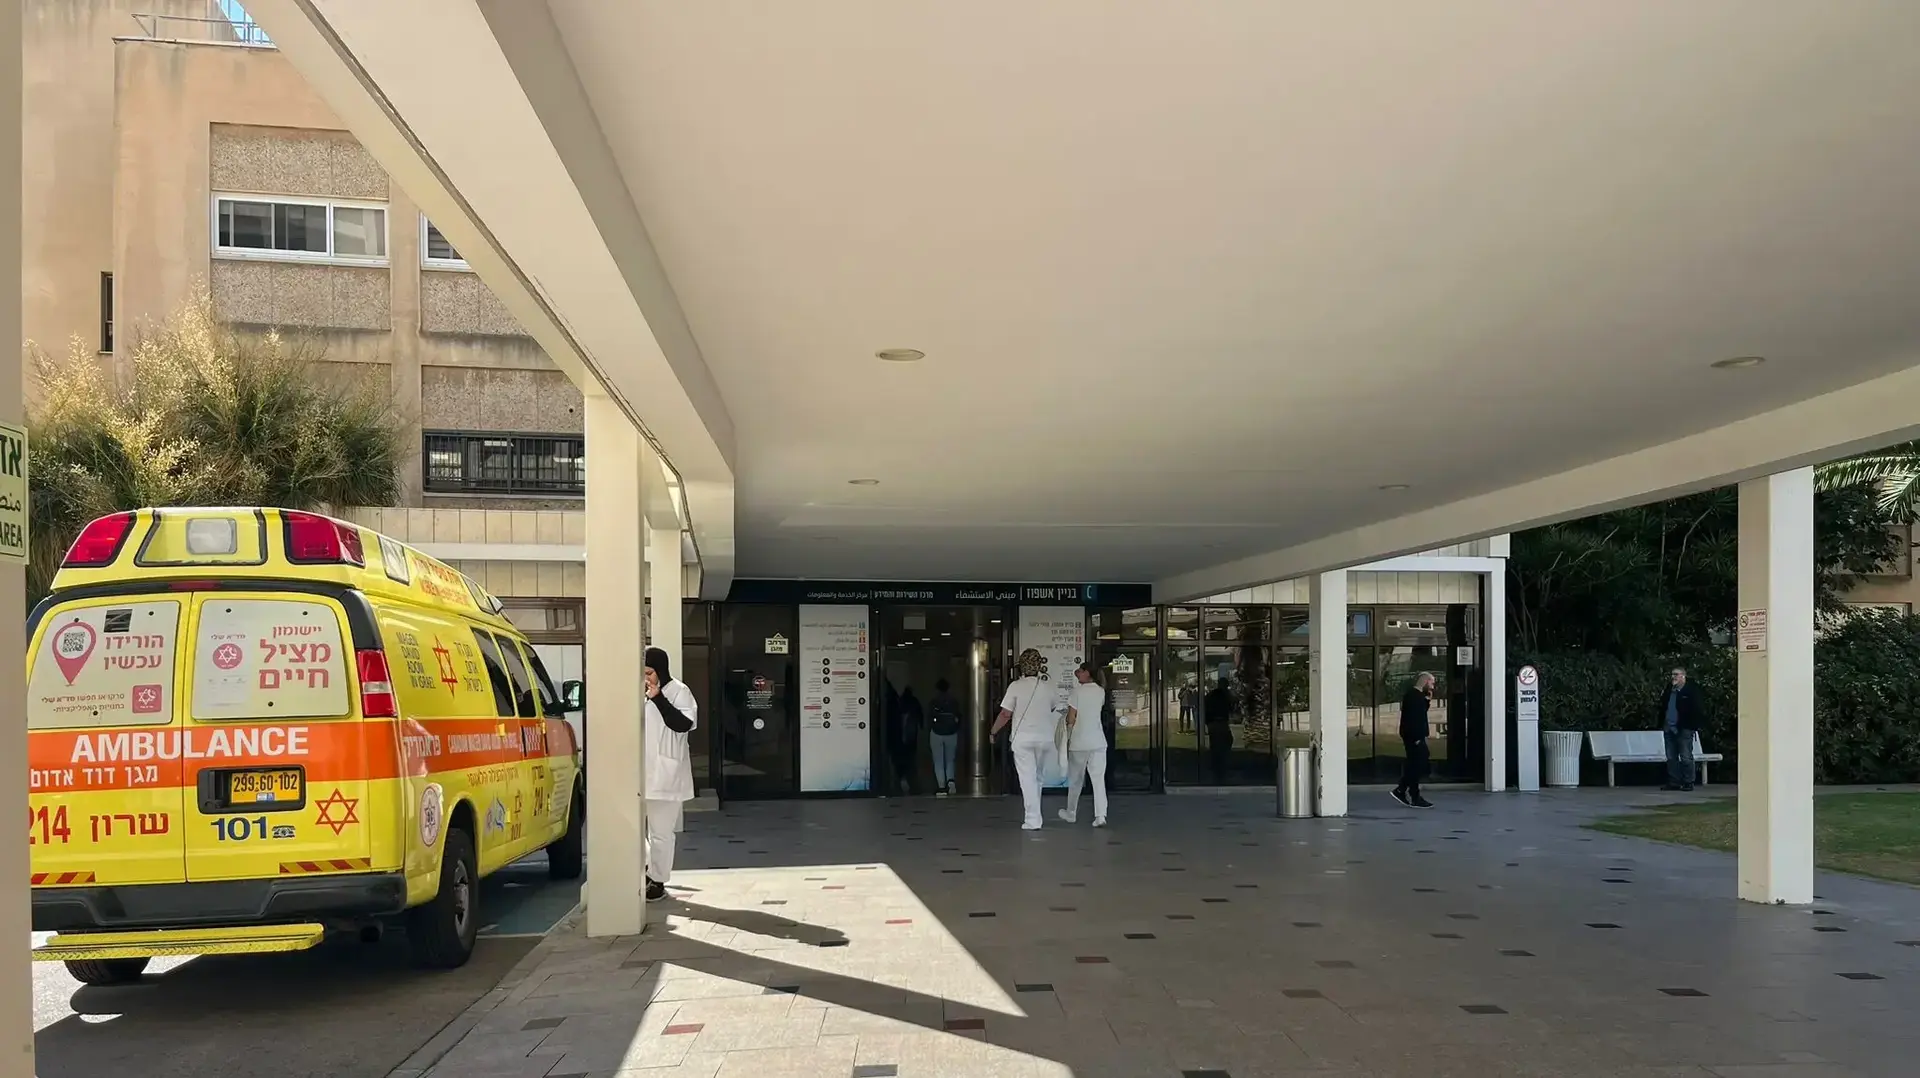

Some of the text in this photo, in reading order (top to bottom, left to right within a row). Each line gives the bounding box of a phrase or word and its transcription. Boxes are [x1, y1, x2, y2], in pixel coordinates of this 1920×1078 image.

[1026, 588, 1077, 600] בניין אשפוז
[105, 634, 164, 650] הורידו
[273, 626, 322, 638] יישומון
[260, 639, 331, 663] מציל
[400, 646, 420, 660] DAVID
[104, 655, 162, 670] עכשיו
[259, 668, 330, 689] חיים
[71, 727, 309, 763] AMBULANCE
[30, 765, 158, 787] מגן דוד אדום
[90, 812, 169, 843] שרון
[210, 816, 267, 841] 101
